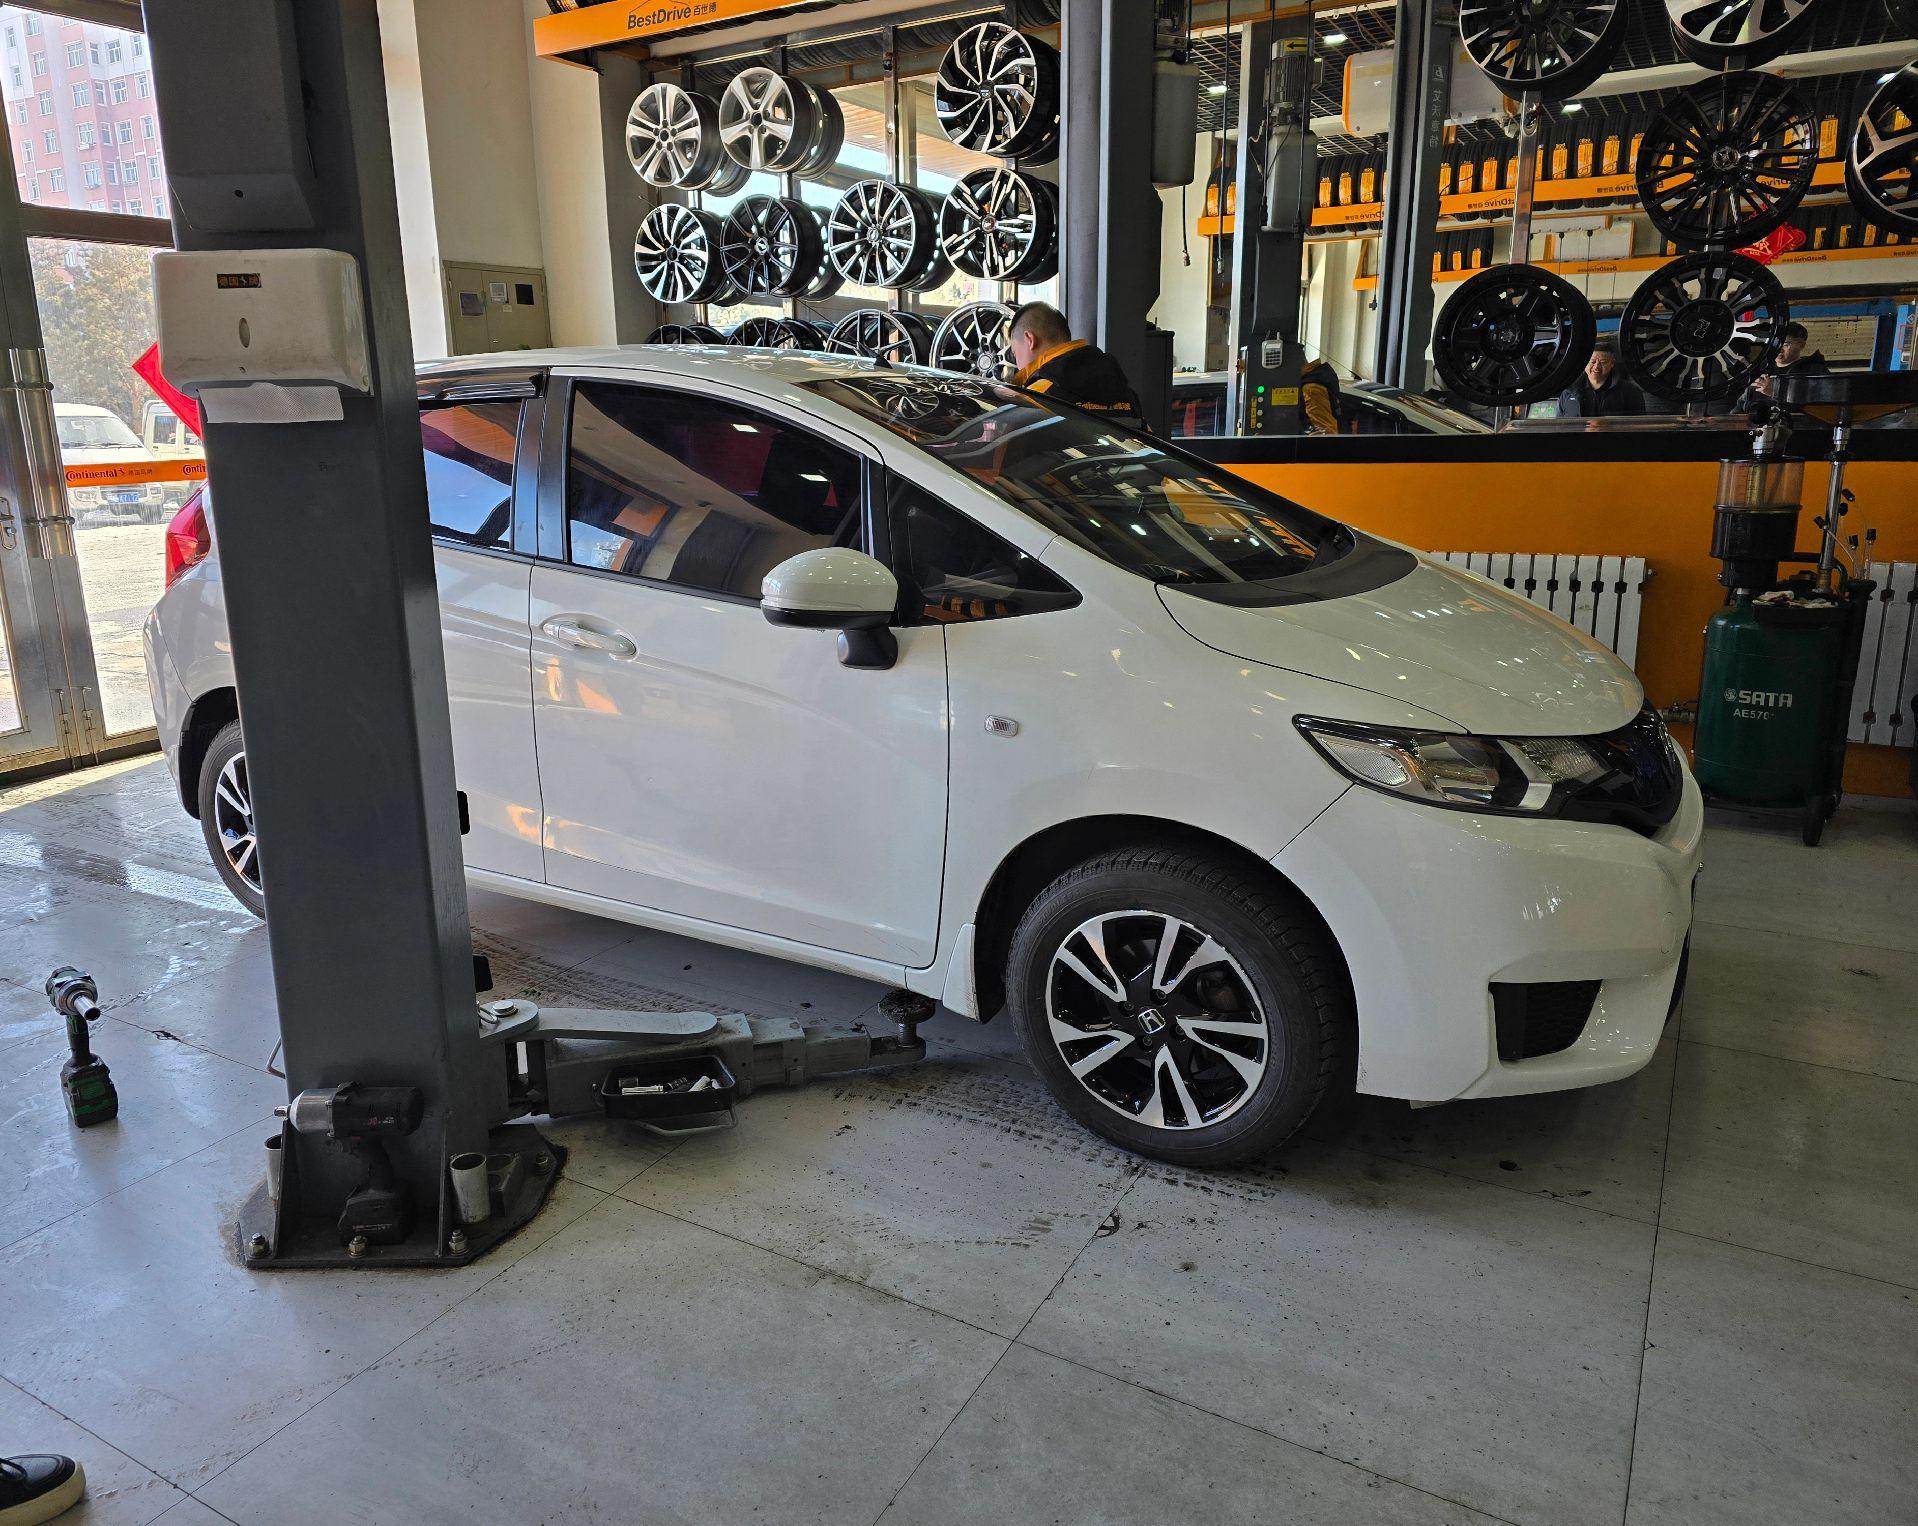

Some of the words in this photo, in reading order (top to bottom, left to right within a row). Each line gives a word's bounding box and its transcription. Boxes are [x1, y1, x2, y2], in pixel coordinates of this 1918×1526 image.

[628, 6, 691, 30] BestDrive
[693, 2, 717, 17] 百世德
[66, 469, 117, 482] Continental
[1738, 690, 1793, 708] SATA
